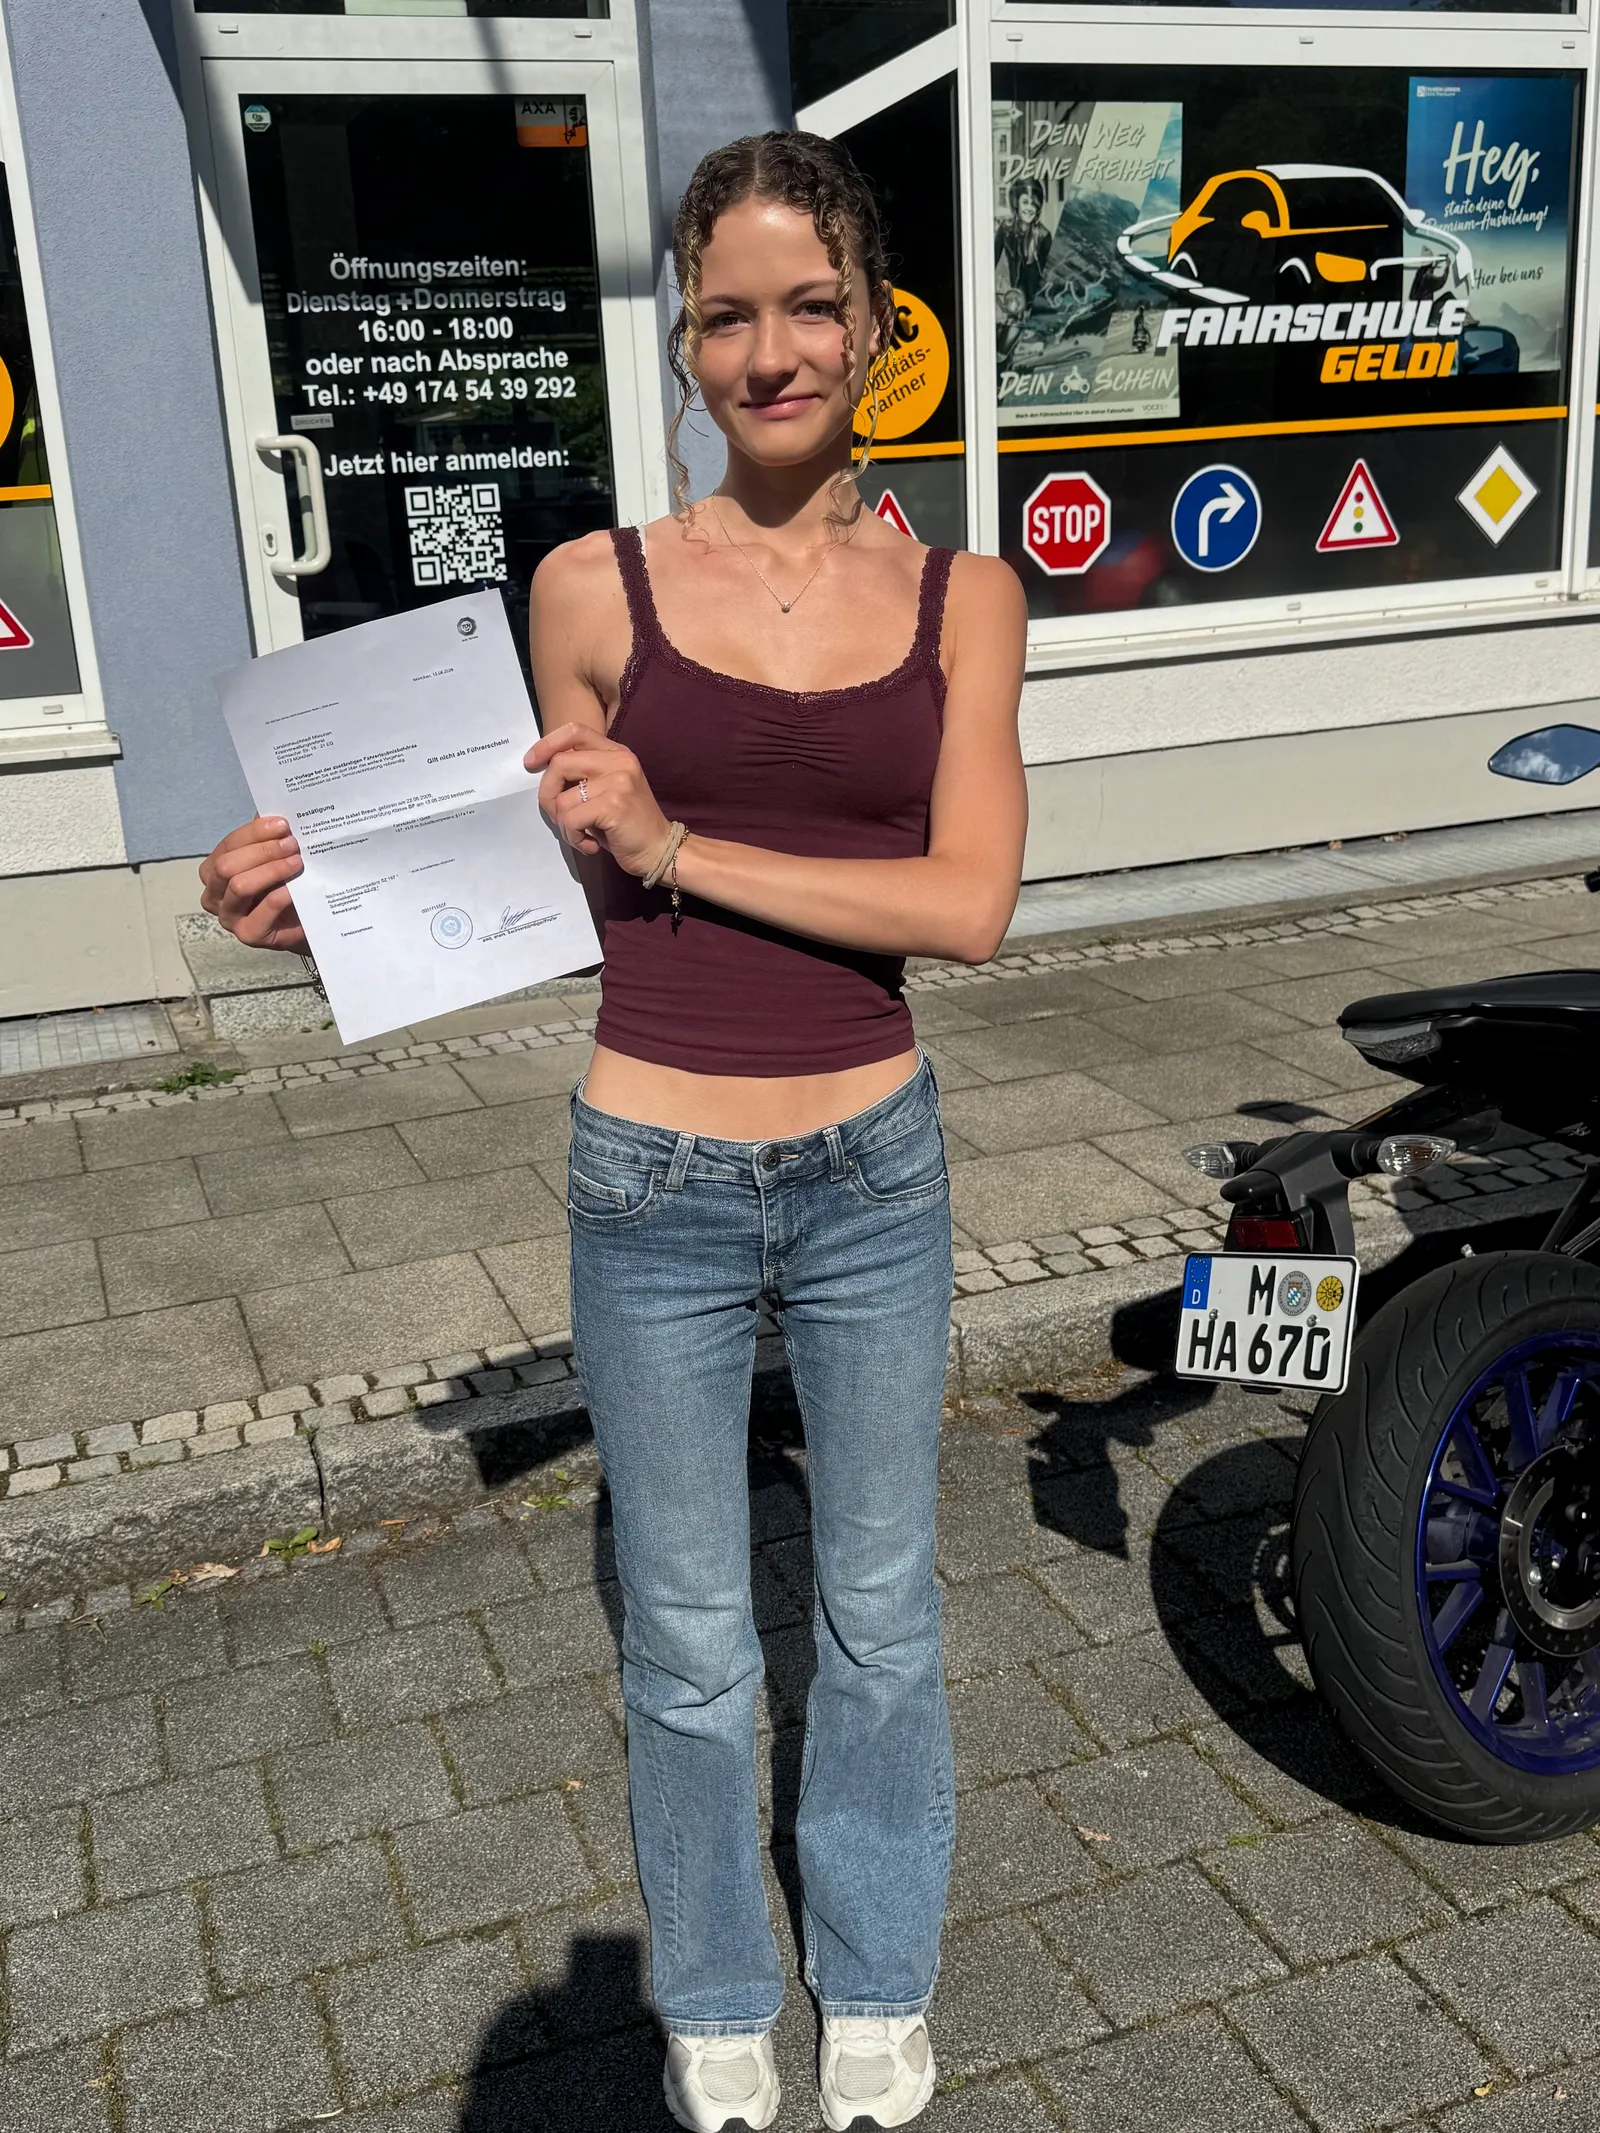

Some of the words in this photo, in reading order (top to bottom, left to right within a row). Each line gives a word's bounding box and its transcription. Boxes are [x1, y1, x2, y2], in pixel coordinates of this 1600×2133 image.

[522, 101, 556, 114] AXA
[1030, 120, 1088, 148] DEIN
[1093, 121, 1146, 149] WEG
[1003, 155, 1072, 183] DEINE
[1077, 154, 1174, 184] FREIHEIT
[1443, 120, 1540, 209] Hey,
[1444, 198, 1475, 217] starte
[1476, 196, 1505, 212] deine
[330, 253, 527, 283] Öffnungszeiten:
[1473, 268, 1497, 289] Hier
[1500, 266, 1517, 283] bei
[1521, 267, 1544, 280] uns
[286, 291, 391, 316] Dienstag
[358, 319, 425, 342] 16:00
[449, 316, 513, 340] 18:00
[1156, 299, 1468, 347] FAHRSCHULE
[306, 353, 363, 375] oder
[371, 350, 431, 373] nach
[438, 346, 568, 374] Absprache
[1320, 341, 1458, 383] GELDI
[302, 384, 355, 406] Tel.:
[364, 382, 407, 404] +49
[416, 380, 458, 402] 174
[466, 379, 493, 400] 54
[500, 378, 528, 399] 39
[536, 376, 576, 398] 292
[866, 373, 926, 420] partner
[998, 372, 1054, 400] DEIN
[1093, 368, 1174, 393] SCHEIN
[324, 454, 385, 476] Jetzt
[391, 451, 438, 473] hier
[446, 447, 569, 472] anmelden:
[1032, 503, 1101, 546] STOP
[440, 753, 455, 761] nicht
[467, 738, 510, 754] Führerschein!
[297, 804, 335, 818] Bestätigung
[1192, 1289, 1200, 1305] D
[1248, 1265, 1277, 1316] M
[1188, 1319, 1237, 1372] HA
[1248, 1323, 1331, 1380] 670
